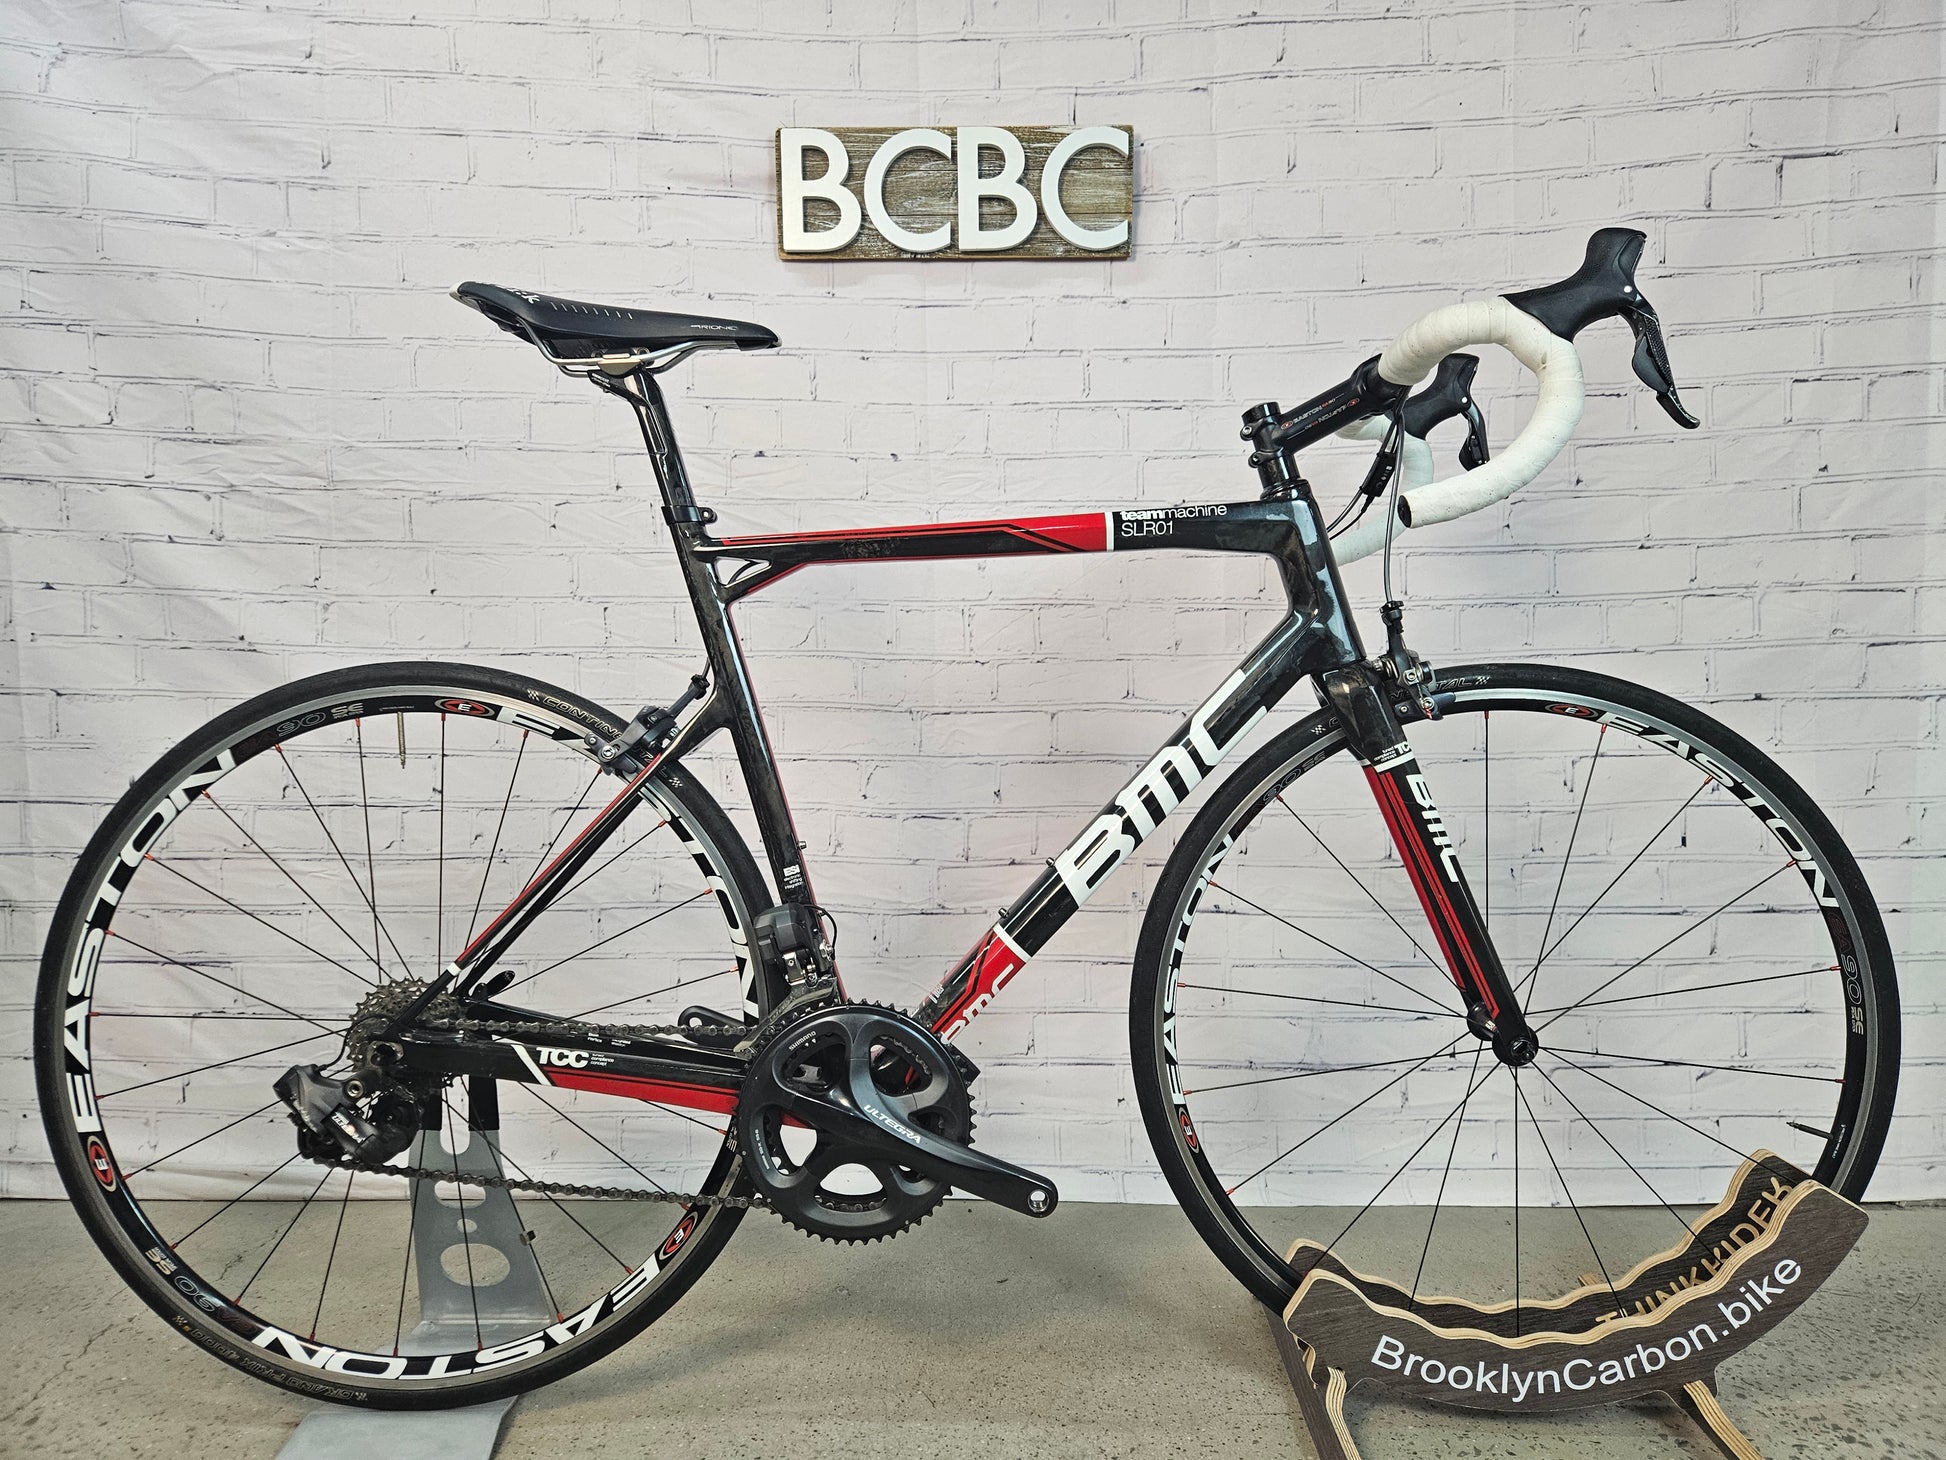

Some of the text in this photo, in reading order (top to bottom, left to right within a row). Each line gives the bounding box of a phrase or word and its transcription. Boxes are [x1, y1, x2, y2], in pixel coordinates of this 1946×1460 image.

[780, 126, 1129, 253] BCBC
[1120, 504, 1228, 521] teammachine
[1121, 520, 1174, 537] SLR01
[1406, 774, 1459, 883] BMC
[1597, 711, 1837, 908] EASTON
[63, 749, 238, 1132] EASTON
[1162, 833, 1234, 1105] EASTON
[536, 1046, 589, 1068] TCC
[788, 1030, 817, 1052] SHIMANO
[863, 1104, 922, 1144] ULTEGRA
[252, 1253, 661, 1381] EASTON
[1371, 1258, 1802, 1403] BrooklynCarbon.bike
